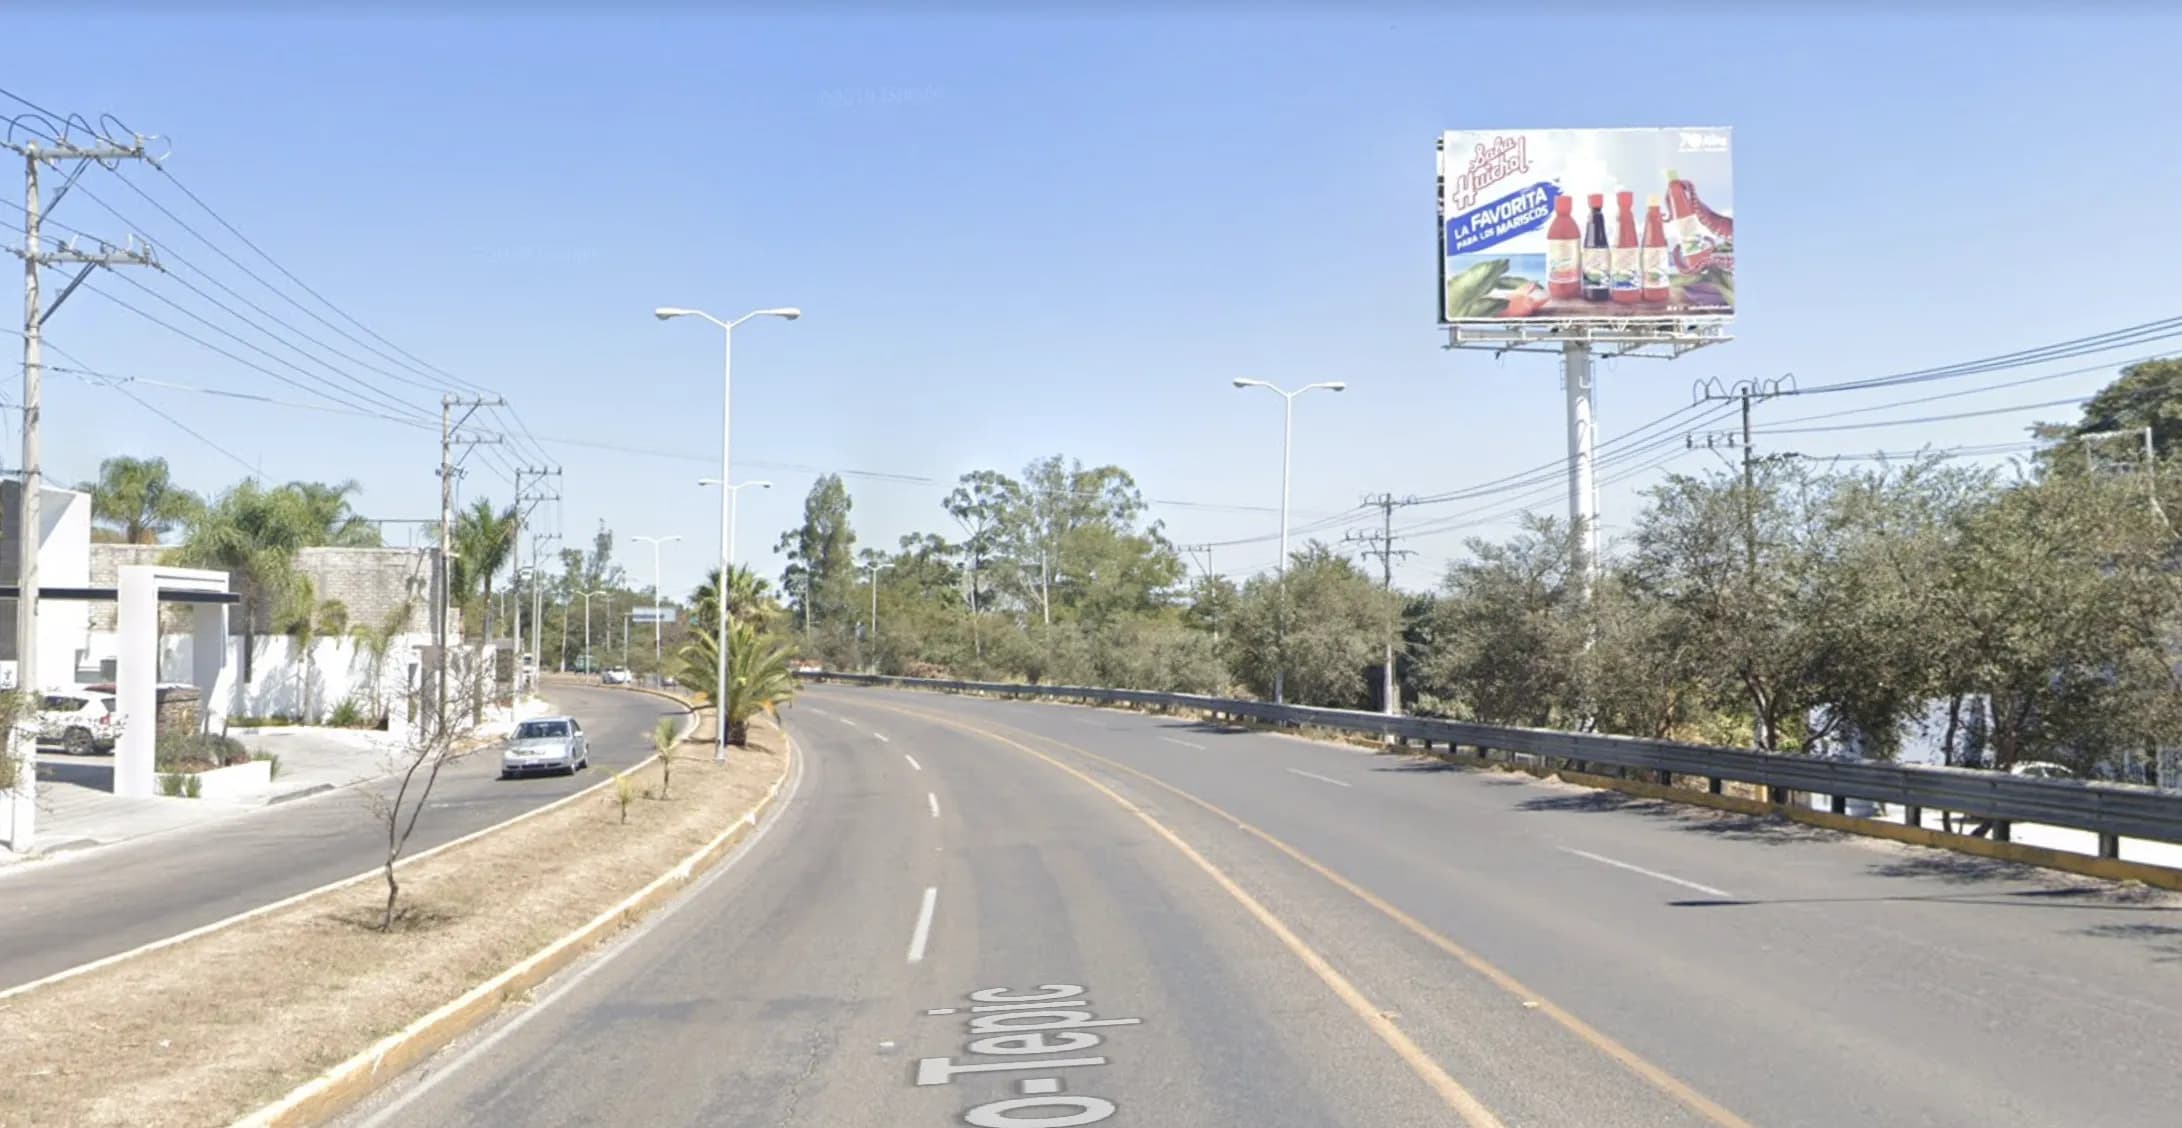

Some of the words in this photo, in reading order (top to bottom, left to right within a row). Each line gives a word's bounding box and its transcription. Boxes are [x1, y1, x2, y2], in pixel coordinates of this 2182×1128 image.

[1453, 136, 1528, 210] Huichol
[1454, 225, 1470, 239] LA
[1471, 187, 1548, 231] FAVORITA
[1456, 235, 1478, 250] PARA
[1480, 227, 1495, 240] LOS
[1496, 204, 1549, 236] MARISCOS
